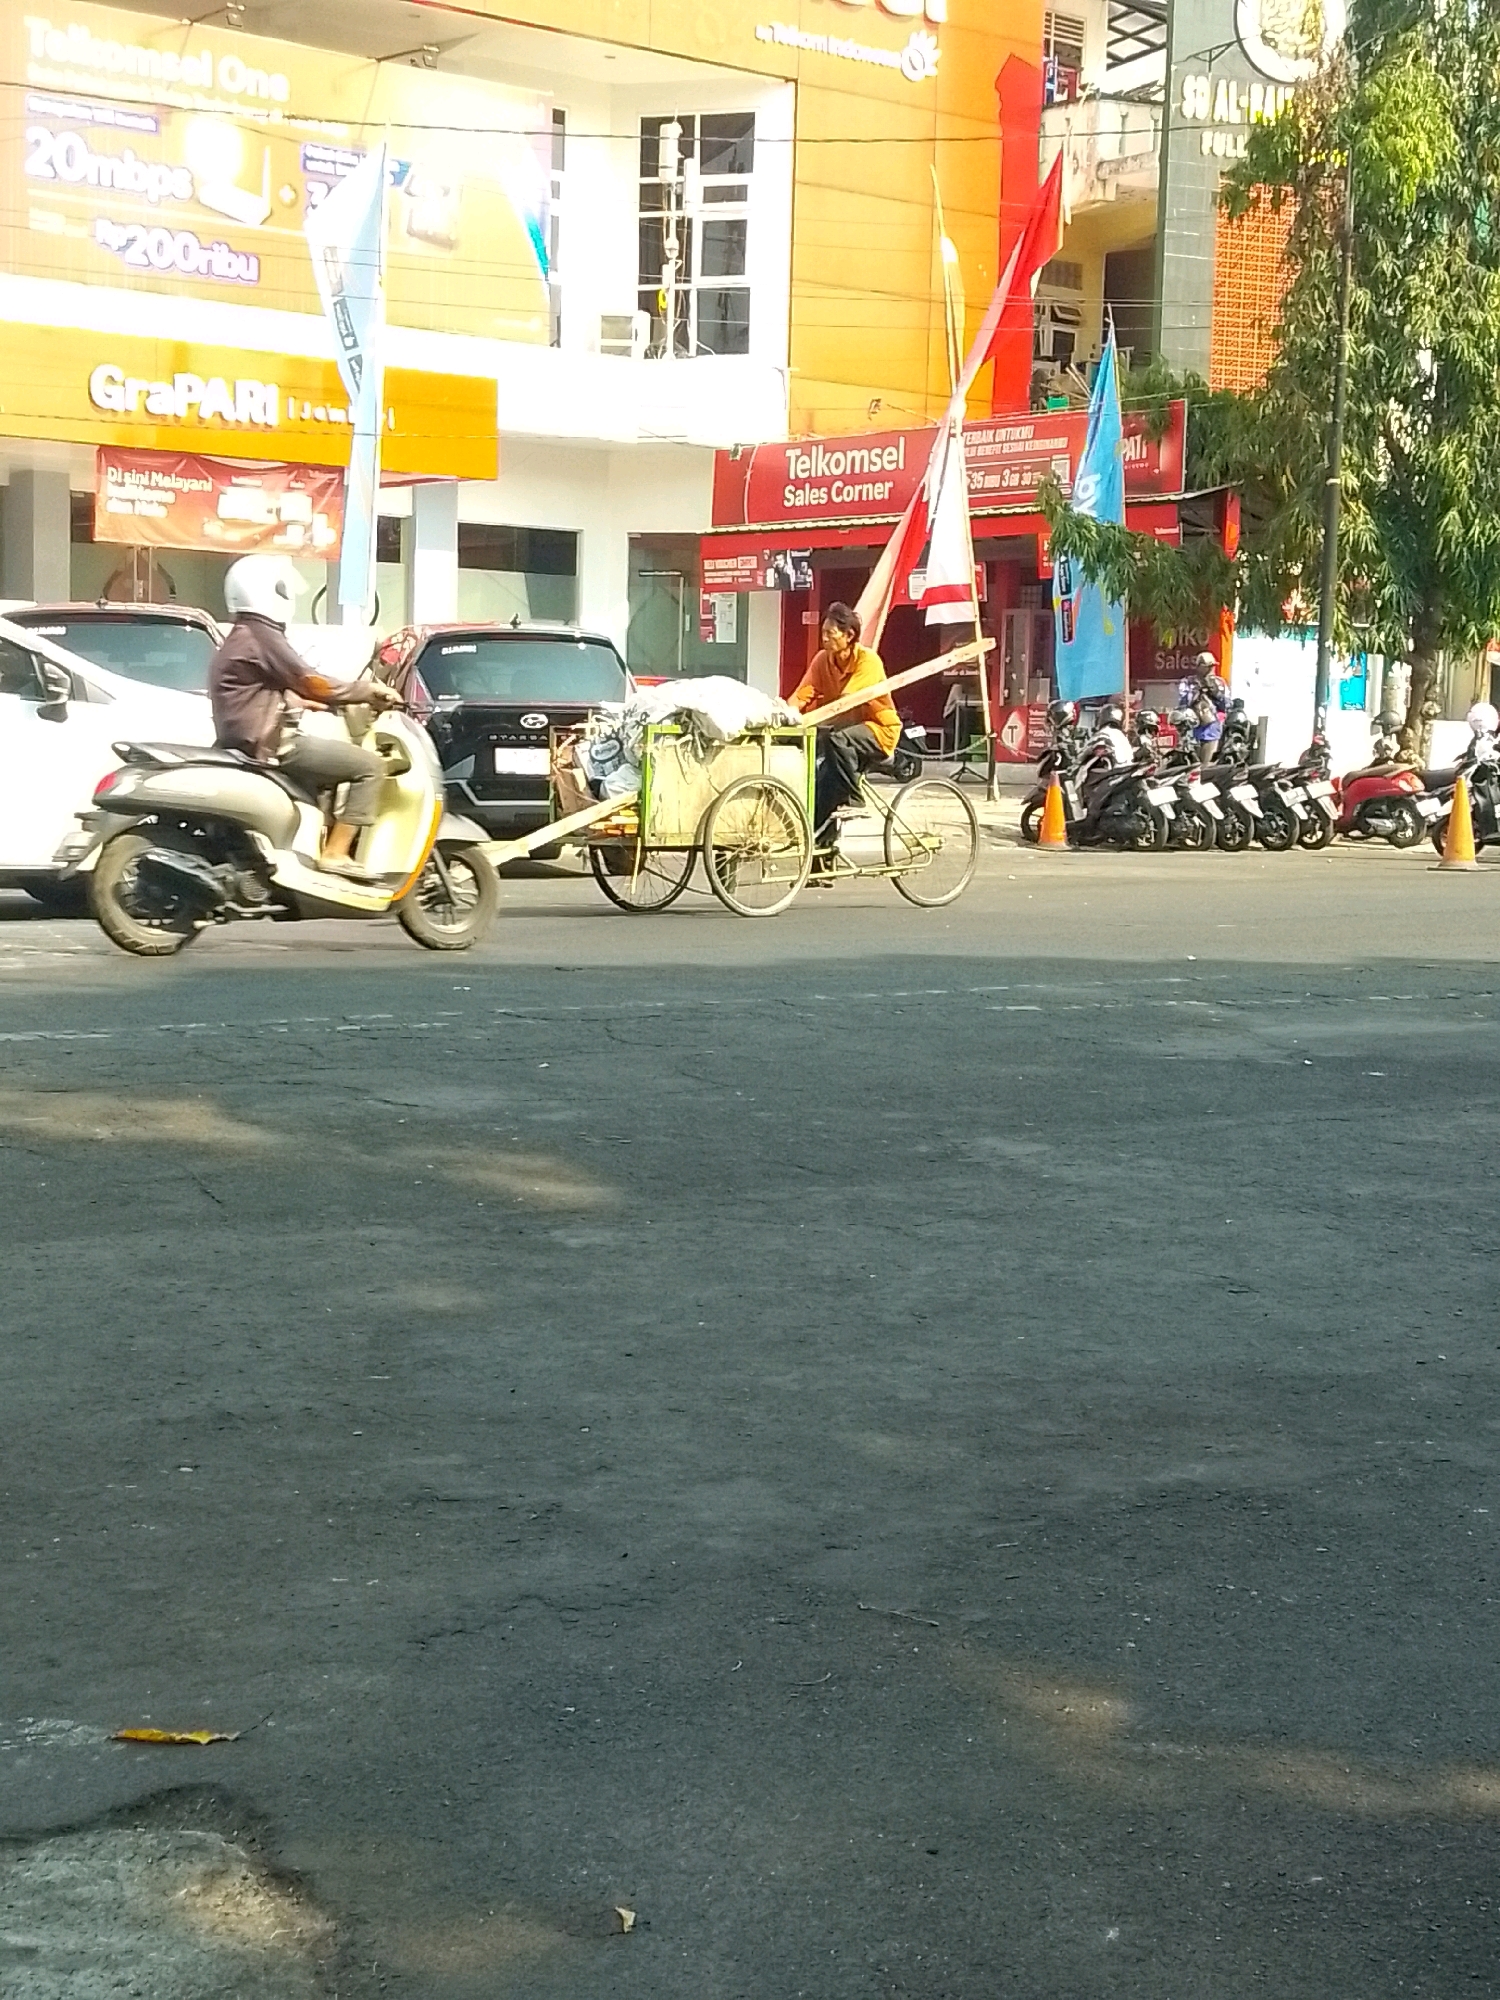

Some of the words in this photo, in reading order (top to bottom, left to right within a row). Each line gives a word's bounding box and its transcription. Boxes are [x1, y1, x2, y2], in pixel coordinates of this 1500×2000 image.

[24, 15, 214, 88] Telkomsel
[217, 54, 290, 102] One
[25, 126, 194, 202] 20mbps
[89, 364, 280, 426] GraPARI
[150, 470, 213, 493] Melayani
[785, 436, 905, 480] Telkomsel
[783, 482, 828, 508] Sales
[831, 480, 894, 503] Corner
